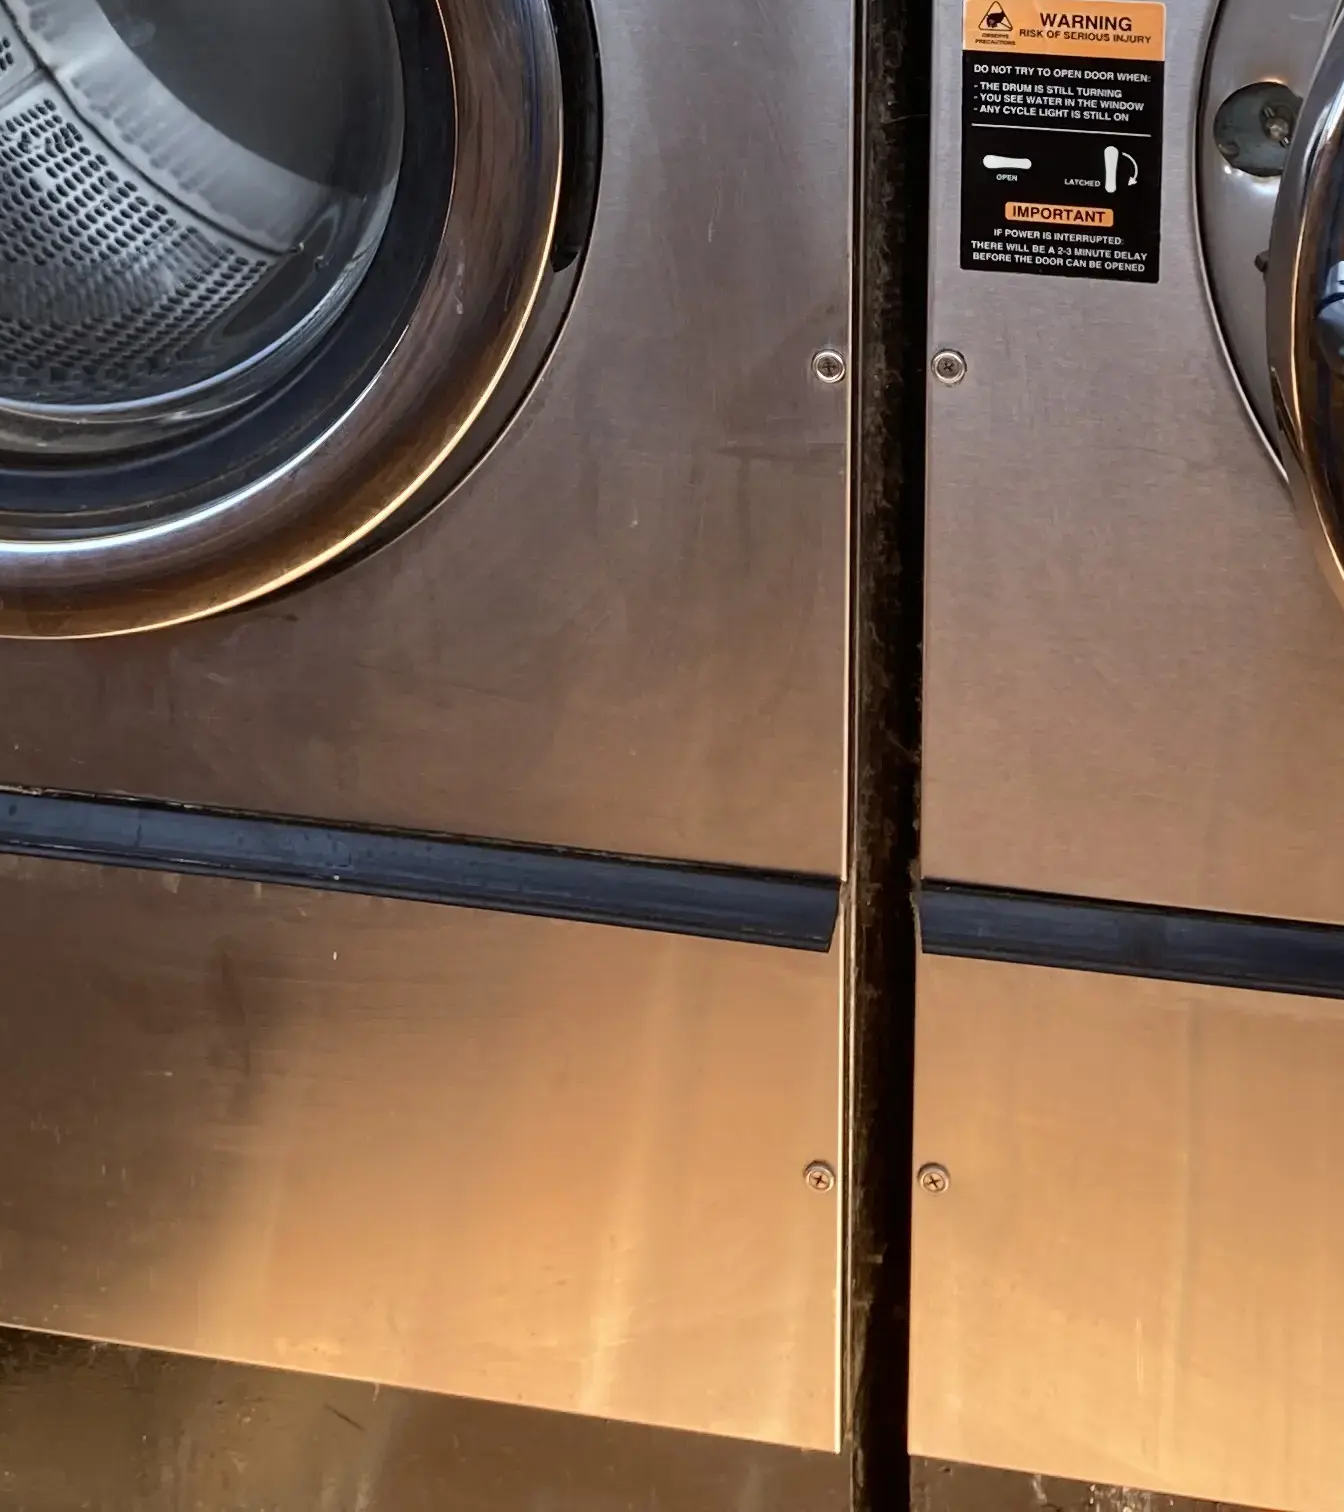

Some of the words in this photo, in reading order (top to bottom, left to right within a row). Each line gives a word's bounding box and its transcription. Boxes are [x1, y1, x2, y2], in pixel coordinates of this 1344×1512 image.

[1040, 13, 1132, 31] WARNING
[1019, 29, 1042, 38] RISK
[1047, 30, 1060, 39] OF
[1064, 31, 1110, 42] SERIOUS
[1113, 34, 1152, 44] INJURY
[974, 65, 988, 73] DO
[991, 66, 1010, 74] NOT
[1015, 66, 1034, 75] TRY
[1037, 67, 1051, 77] TO
[1053, 69, 1081, 78] OPEN
[1084, 70, 1114, 81] DOOR
[980, 82, 999, 91] THE
[1002, 83, 1032, 93] DRUM
[1035, 85, 1043, 94] IS
[1046, 85, 1074, 96] STILL
[1076, 87, 1122, 98] TURNING
[980, 93, 1001, 102] YOU
[1004, 94, 1023, 104] SEE
[1026, 96, 1062, 106] WATER
[1064, 98, 1075, 106] IN
[1078, 99, 1097, 108] THE
[1100, 100, 1144, 111] WINDOW
[980, 105, 1000, 114] ANY
[1003, 106, 1036, 116] CYCLE
[1039, 108, 1068, 118] LIGHT
[1071, 109, 1081, 119] IS
[1083, 110, 1111, 121] STILL
[1113, 112, 1129, 122] ON
[996, 174, 1018, 182] OPEN
[1064, 179, 1101, 187] LATCHED
[1012, 205, 1106, 223] IMPORTANT
[1005, 229, 1040, 239] POWER
[1043, 231, 1051, 240] IS
[971, 240, 1003, 250] THERE
[1006, 242, 1029, 252] WILL
[1032, 245, 1046, 253] BE
[1048, 246, 1055, 254] A
[1058, 247, 1072, 255] 2-3
[1074, 248, 1111, 258] MINUTE
[1114, 251, 1147, 261] DELAY
[973, 252, 1011, 262] BEFORE
[1014, 254, 1033, 264] THE
[1035, 256, 1063, 266] DOOR
[1066, 258, 1087, 267] CAN
[1089, 260, 1102, 269] BE
[1105, 261, 1145, 272] OPENED
